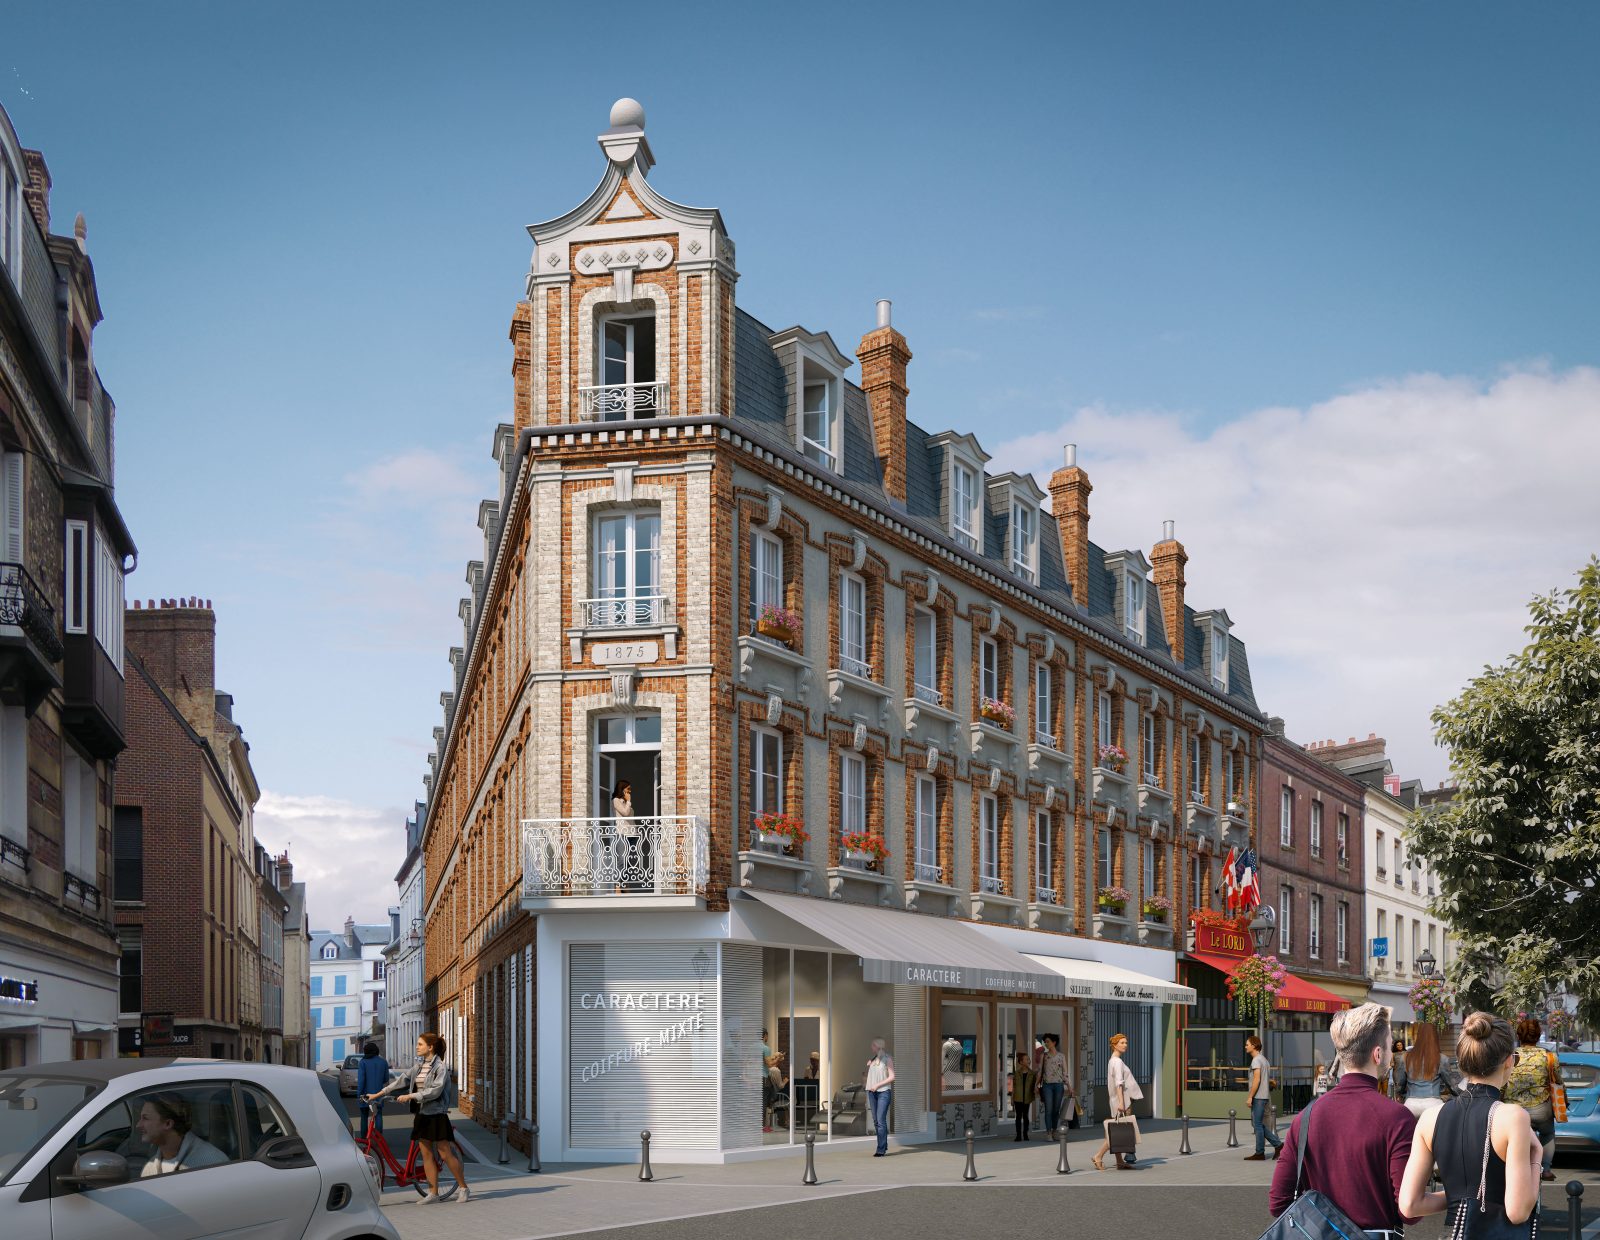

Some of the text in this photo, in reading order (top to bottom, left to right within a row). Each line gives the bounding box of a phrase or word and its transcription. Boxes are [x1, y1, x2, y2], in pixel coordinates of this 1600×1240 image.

[605, 646, 645, 659] 1875
[1210, 931, 1245, 951] Le LORD
[907, 967, 961, 984] CARACTERE
[985, 977, 1036, 989] COIFFURE MIXTE
[581, 993, 705, 1009] CARACTERE
[582, 1011, 704, 1083] COIFFURE MIXTE
